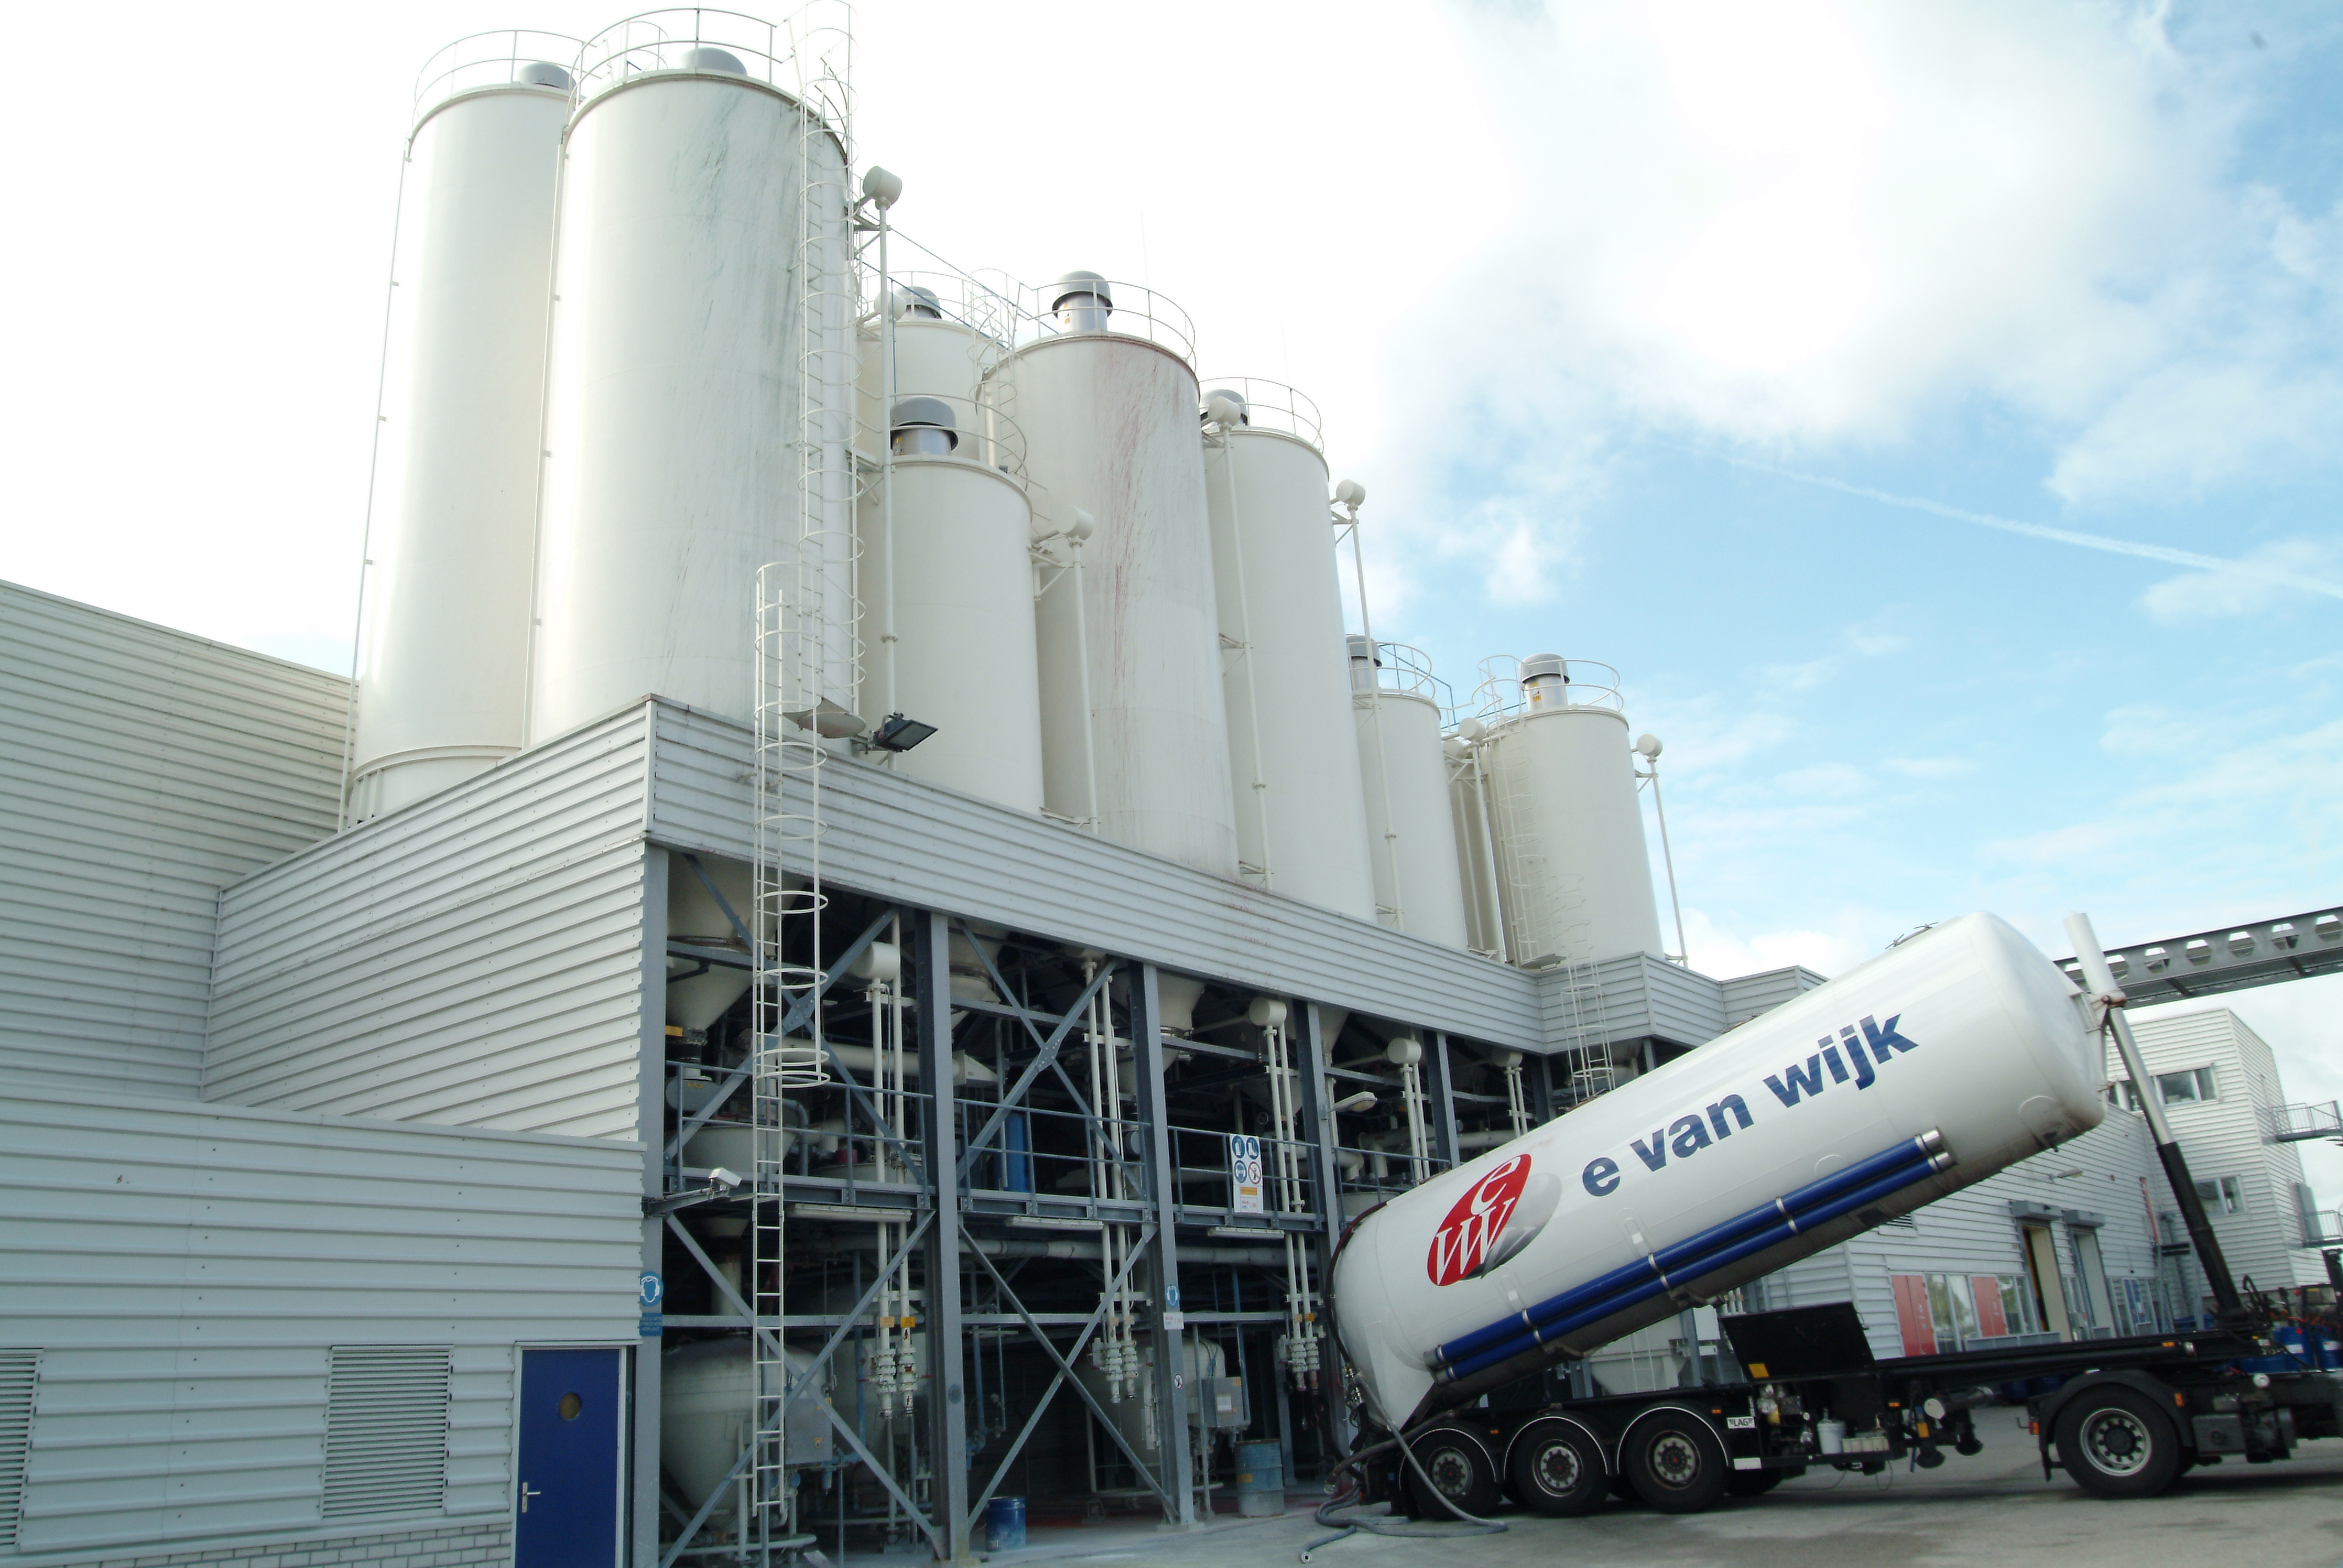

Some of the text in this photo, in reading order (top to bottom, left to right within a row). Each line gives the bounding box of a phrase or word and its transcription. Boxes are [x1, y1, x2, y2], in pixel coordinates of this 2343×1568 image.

[1582, 1014, 1919, 1197] e van wijk
[1734, 1418, 1748, 1427] LAG
